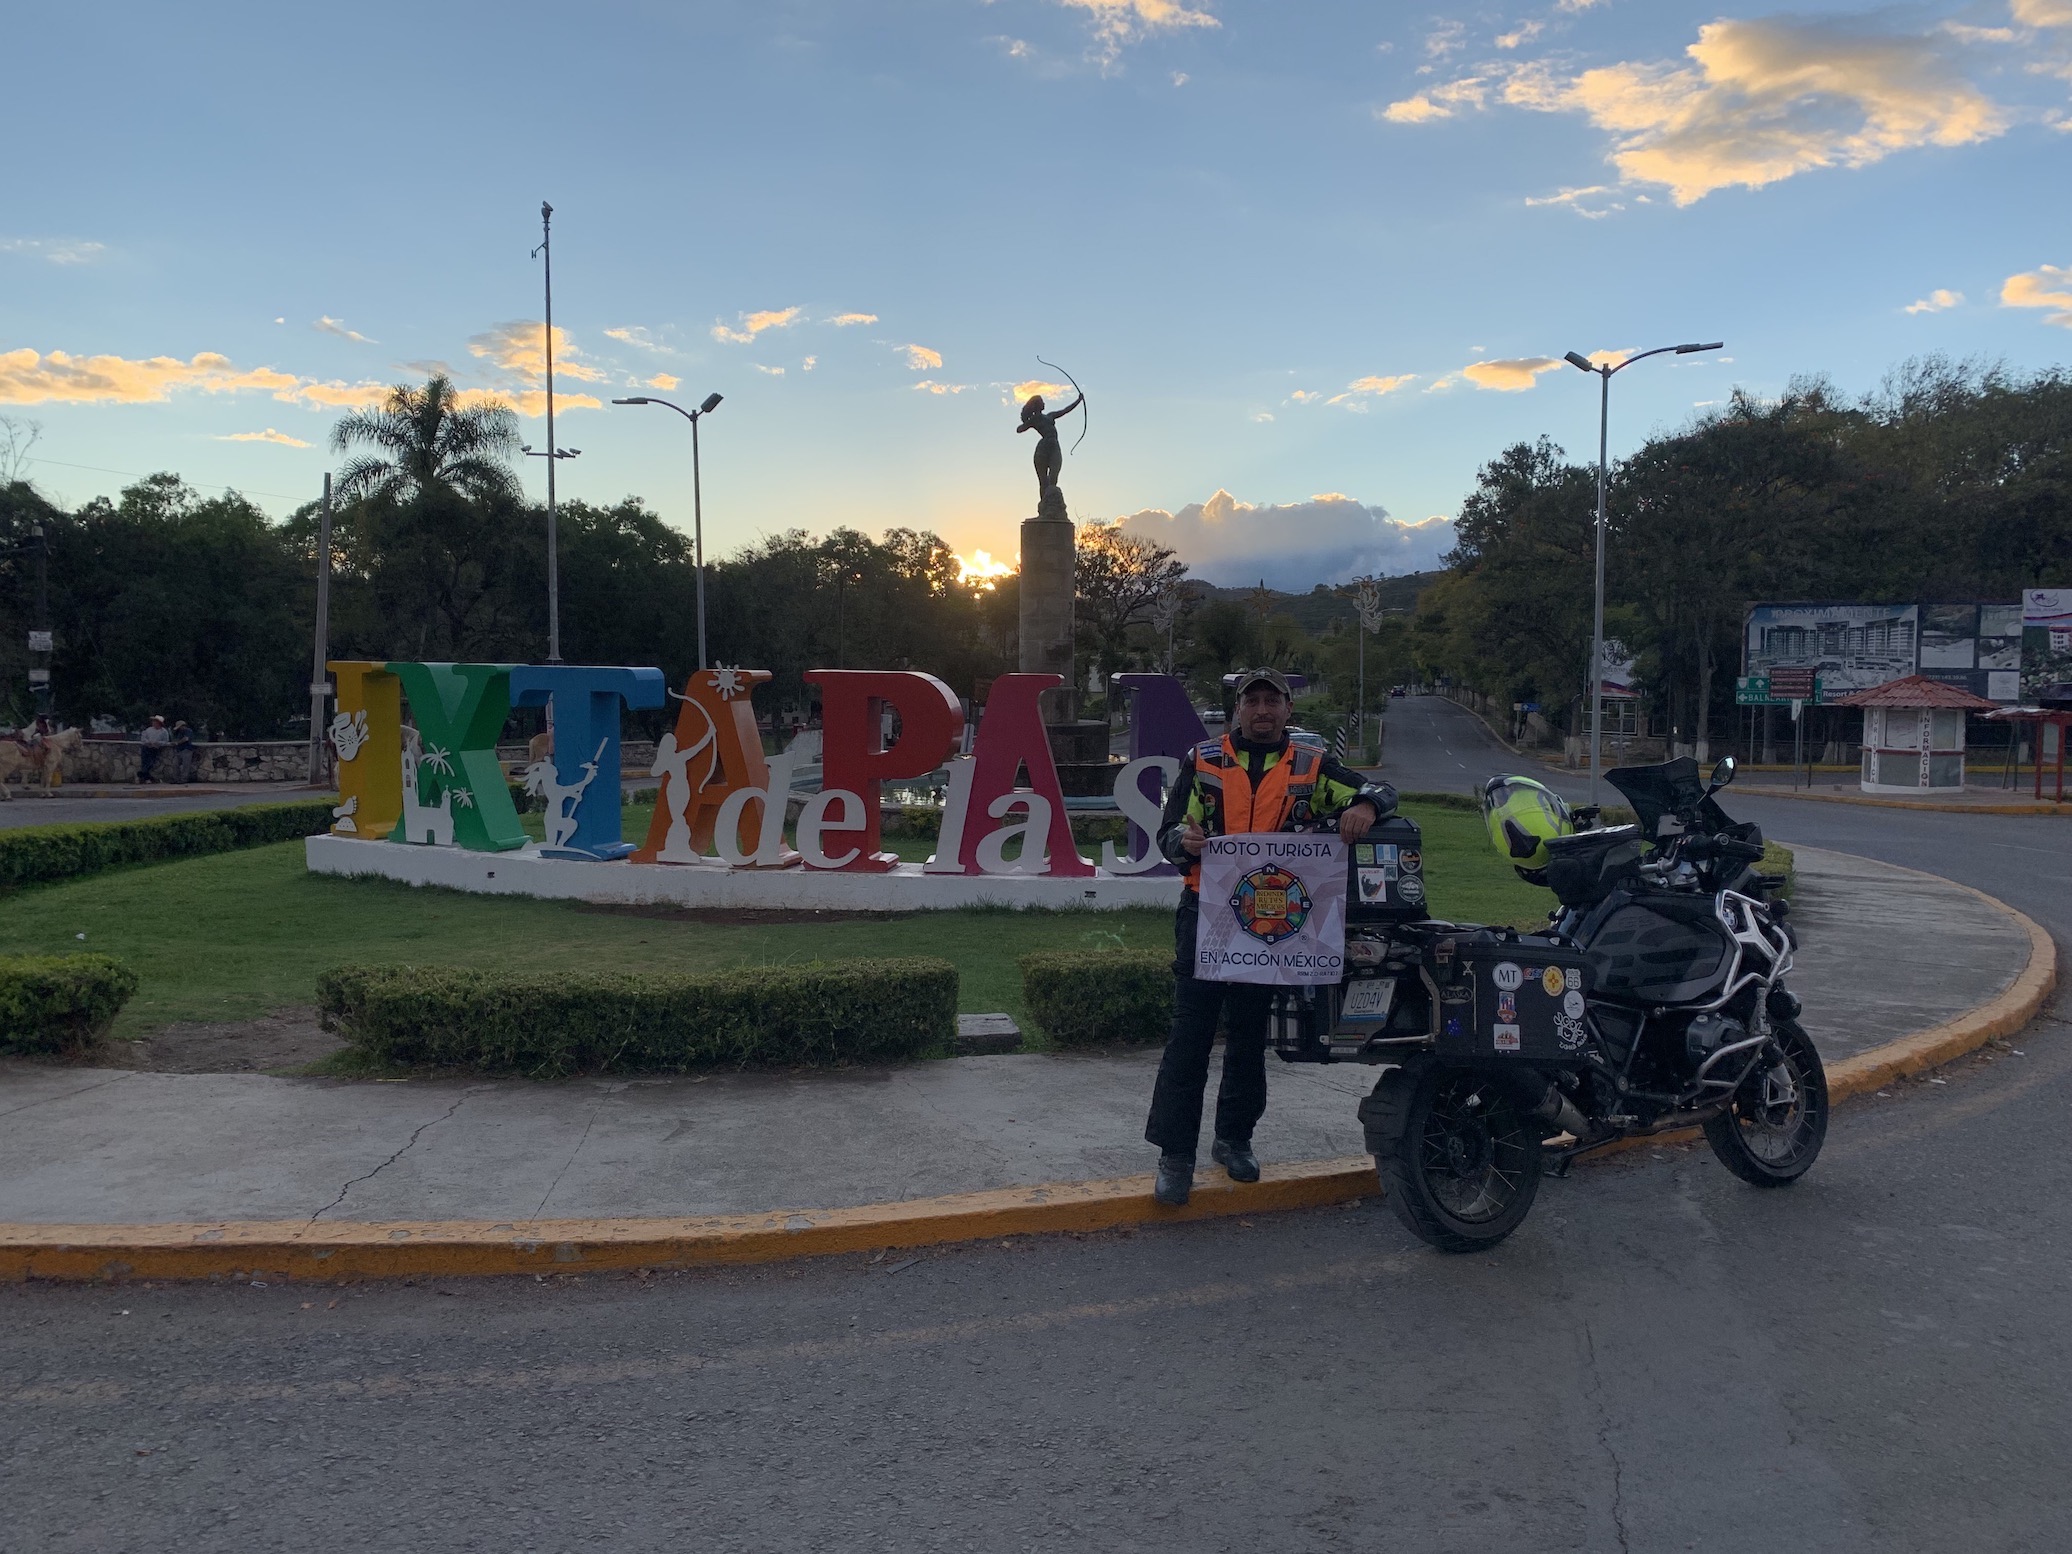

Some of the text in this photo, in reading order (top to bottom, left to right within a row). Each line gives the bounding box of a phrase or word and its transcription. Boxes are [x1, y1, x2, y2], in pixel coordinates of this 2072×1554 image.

[1921, 710, 1930, 787] INFORMACION
[714, 751, 868, 869] de
[1209, 840, 1331, 857] MOTO TURISTA
[1200, 950, 1341, 968] EN ACCIÓN MÉXICO
[1498, 969, 1517, 983] MT
[1567, 976, 1580, 987] 66
[1441, 991, 1470, 999] ALASKA
